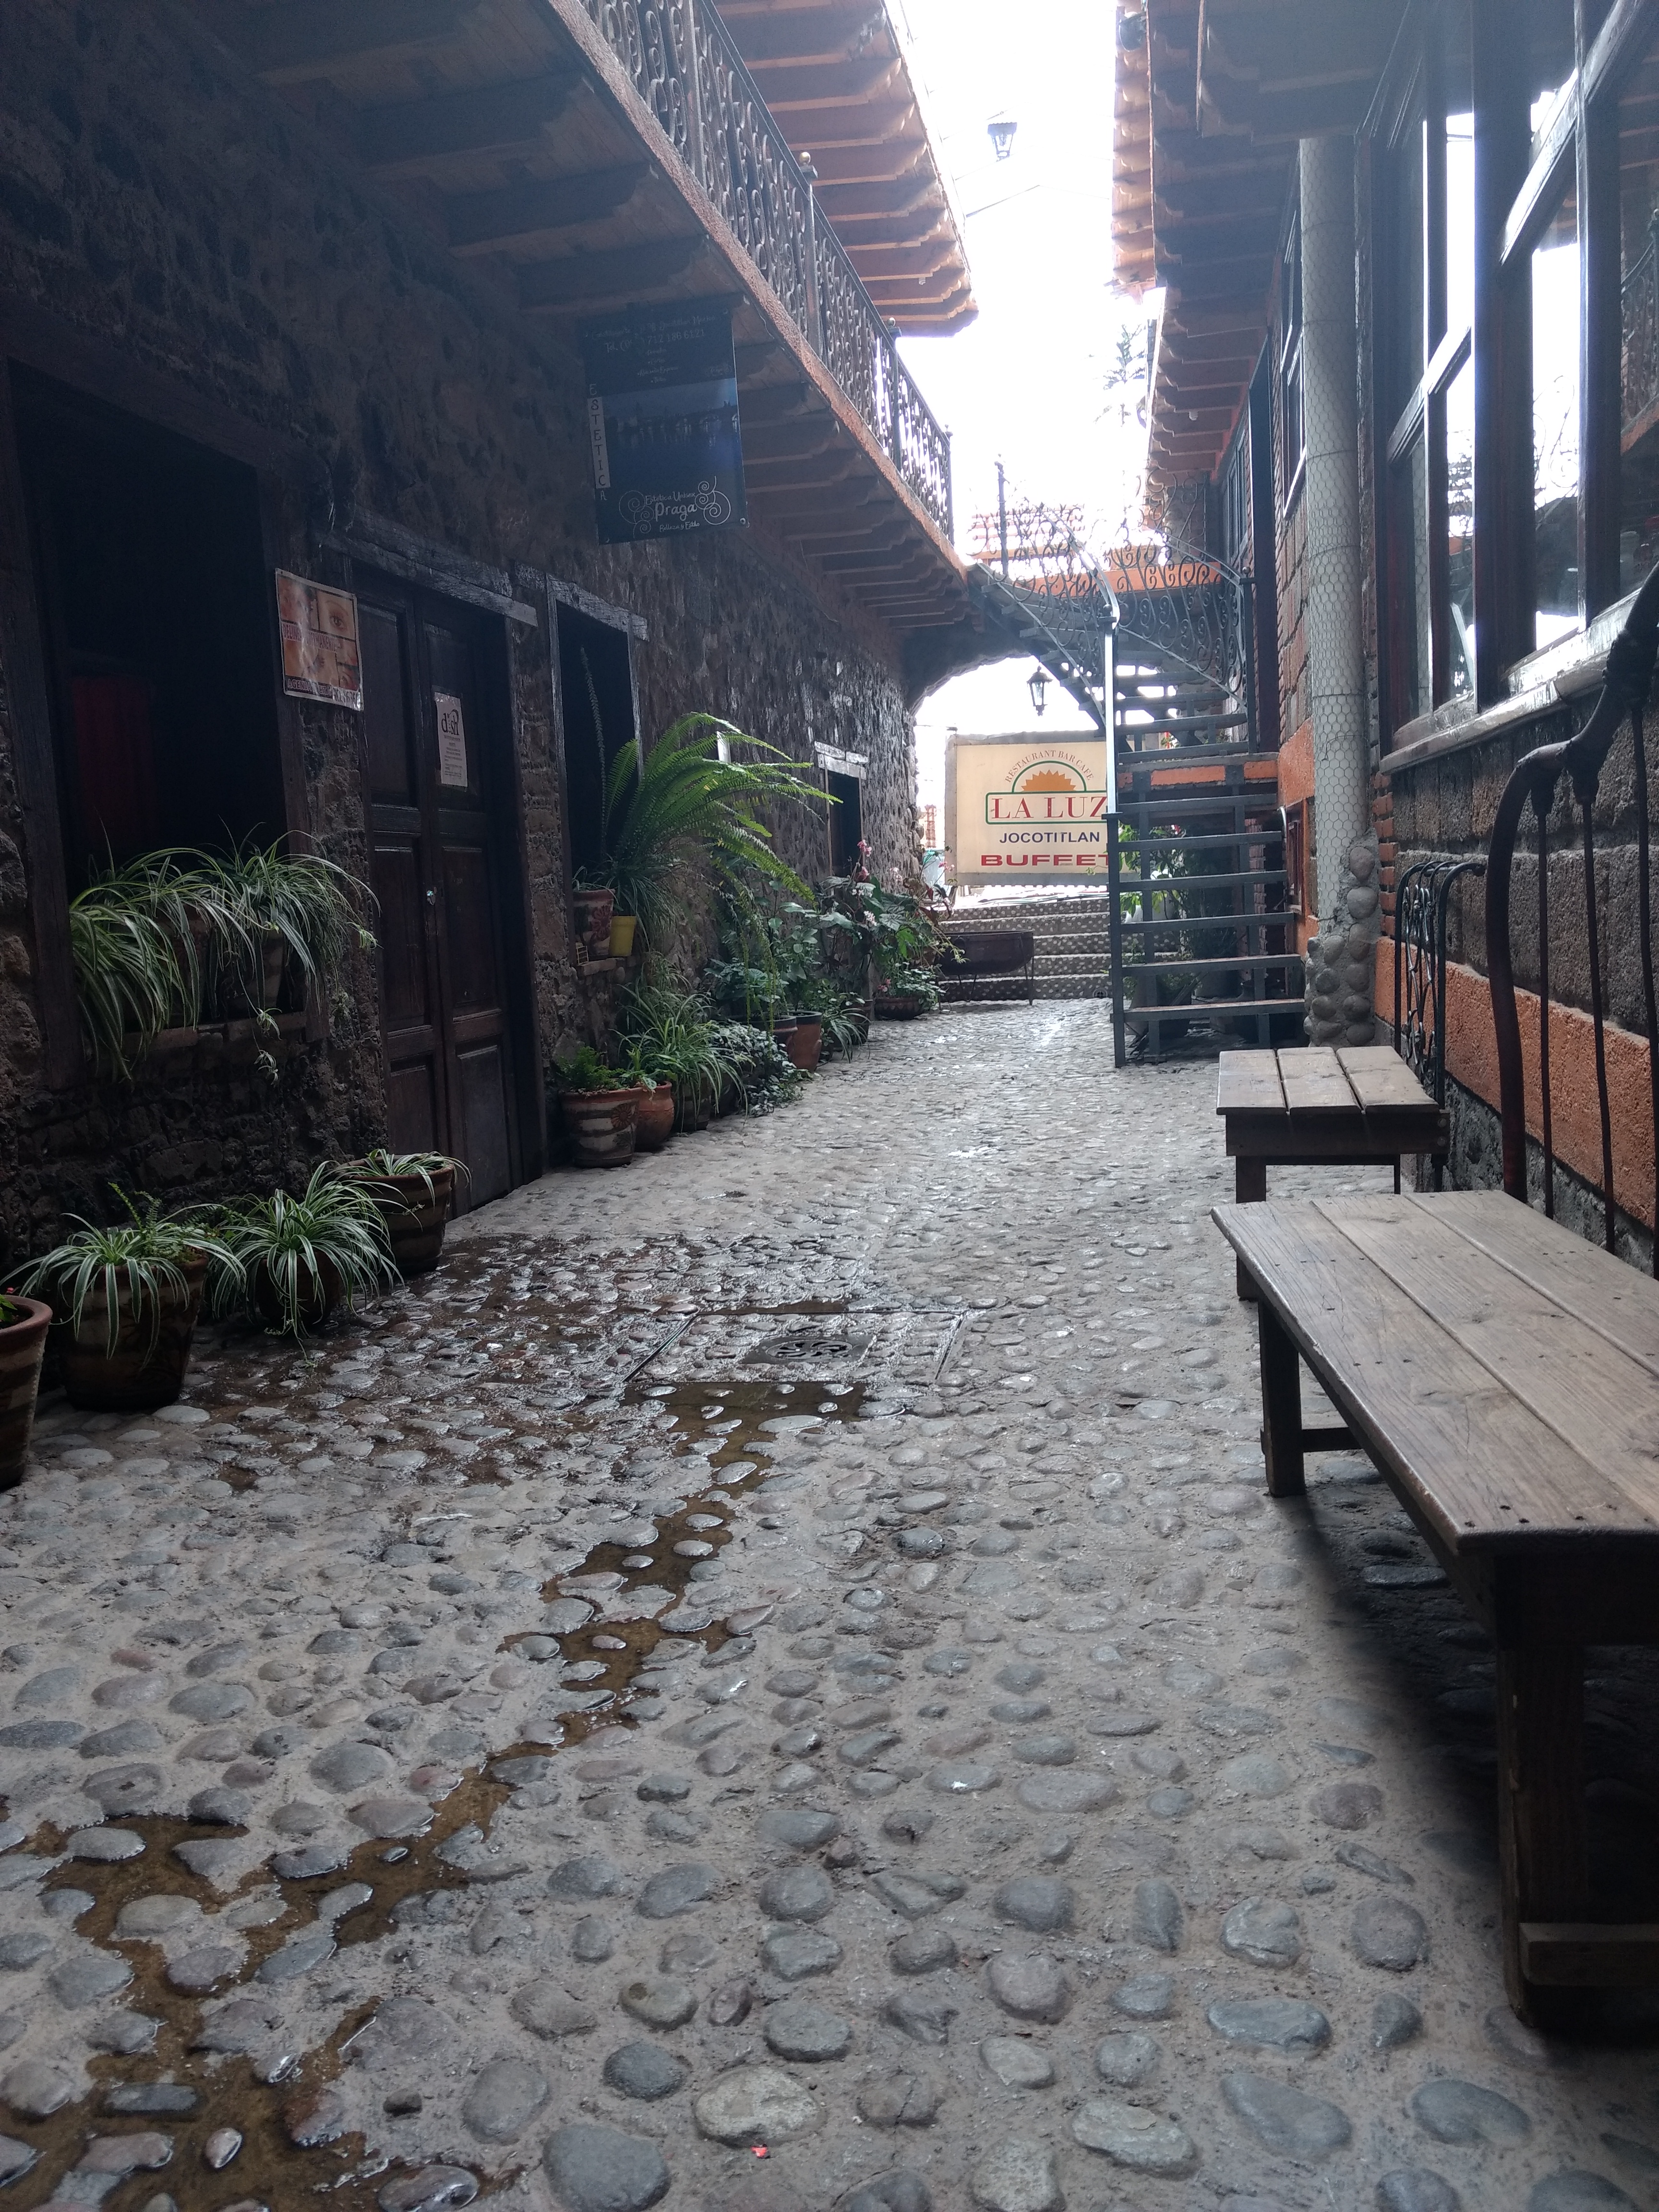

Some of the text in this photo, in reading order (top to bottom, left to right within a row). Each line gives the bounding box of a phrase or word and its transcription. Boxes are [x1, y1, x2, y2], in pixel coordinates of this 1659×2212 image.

[589, 384, 607, 501] ESTETICA
[655, 502, 698, 522] Praga
[288, 678, 312, 692] AGENDA
[441, 709, 459, 735] dish
[1005, 750, 1094, 783] RESTAURANT BAR CAFE
[991, 796, 1107, 819] LA LUZ
[999, 831, 1100, 843] JOCOTITLAN
